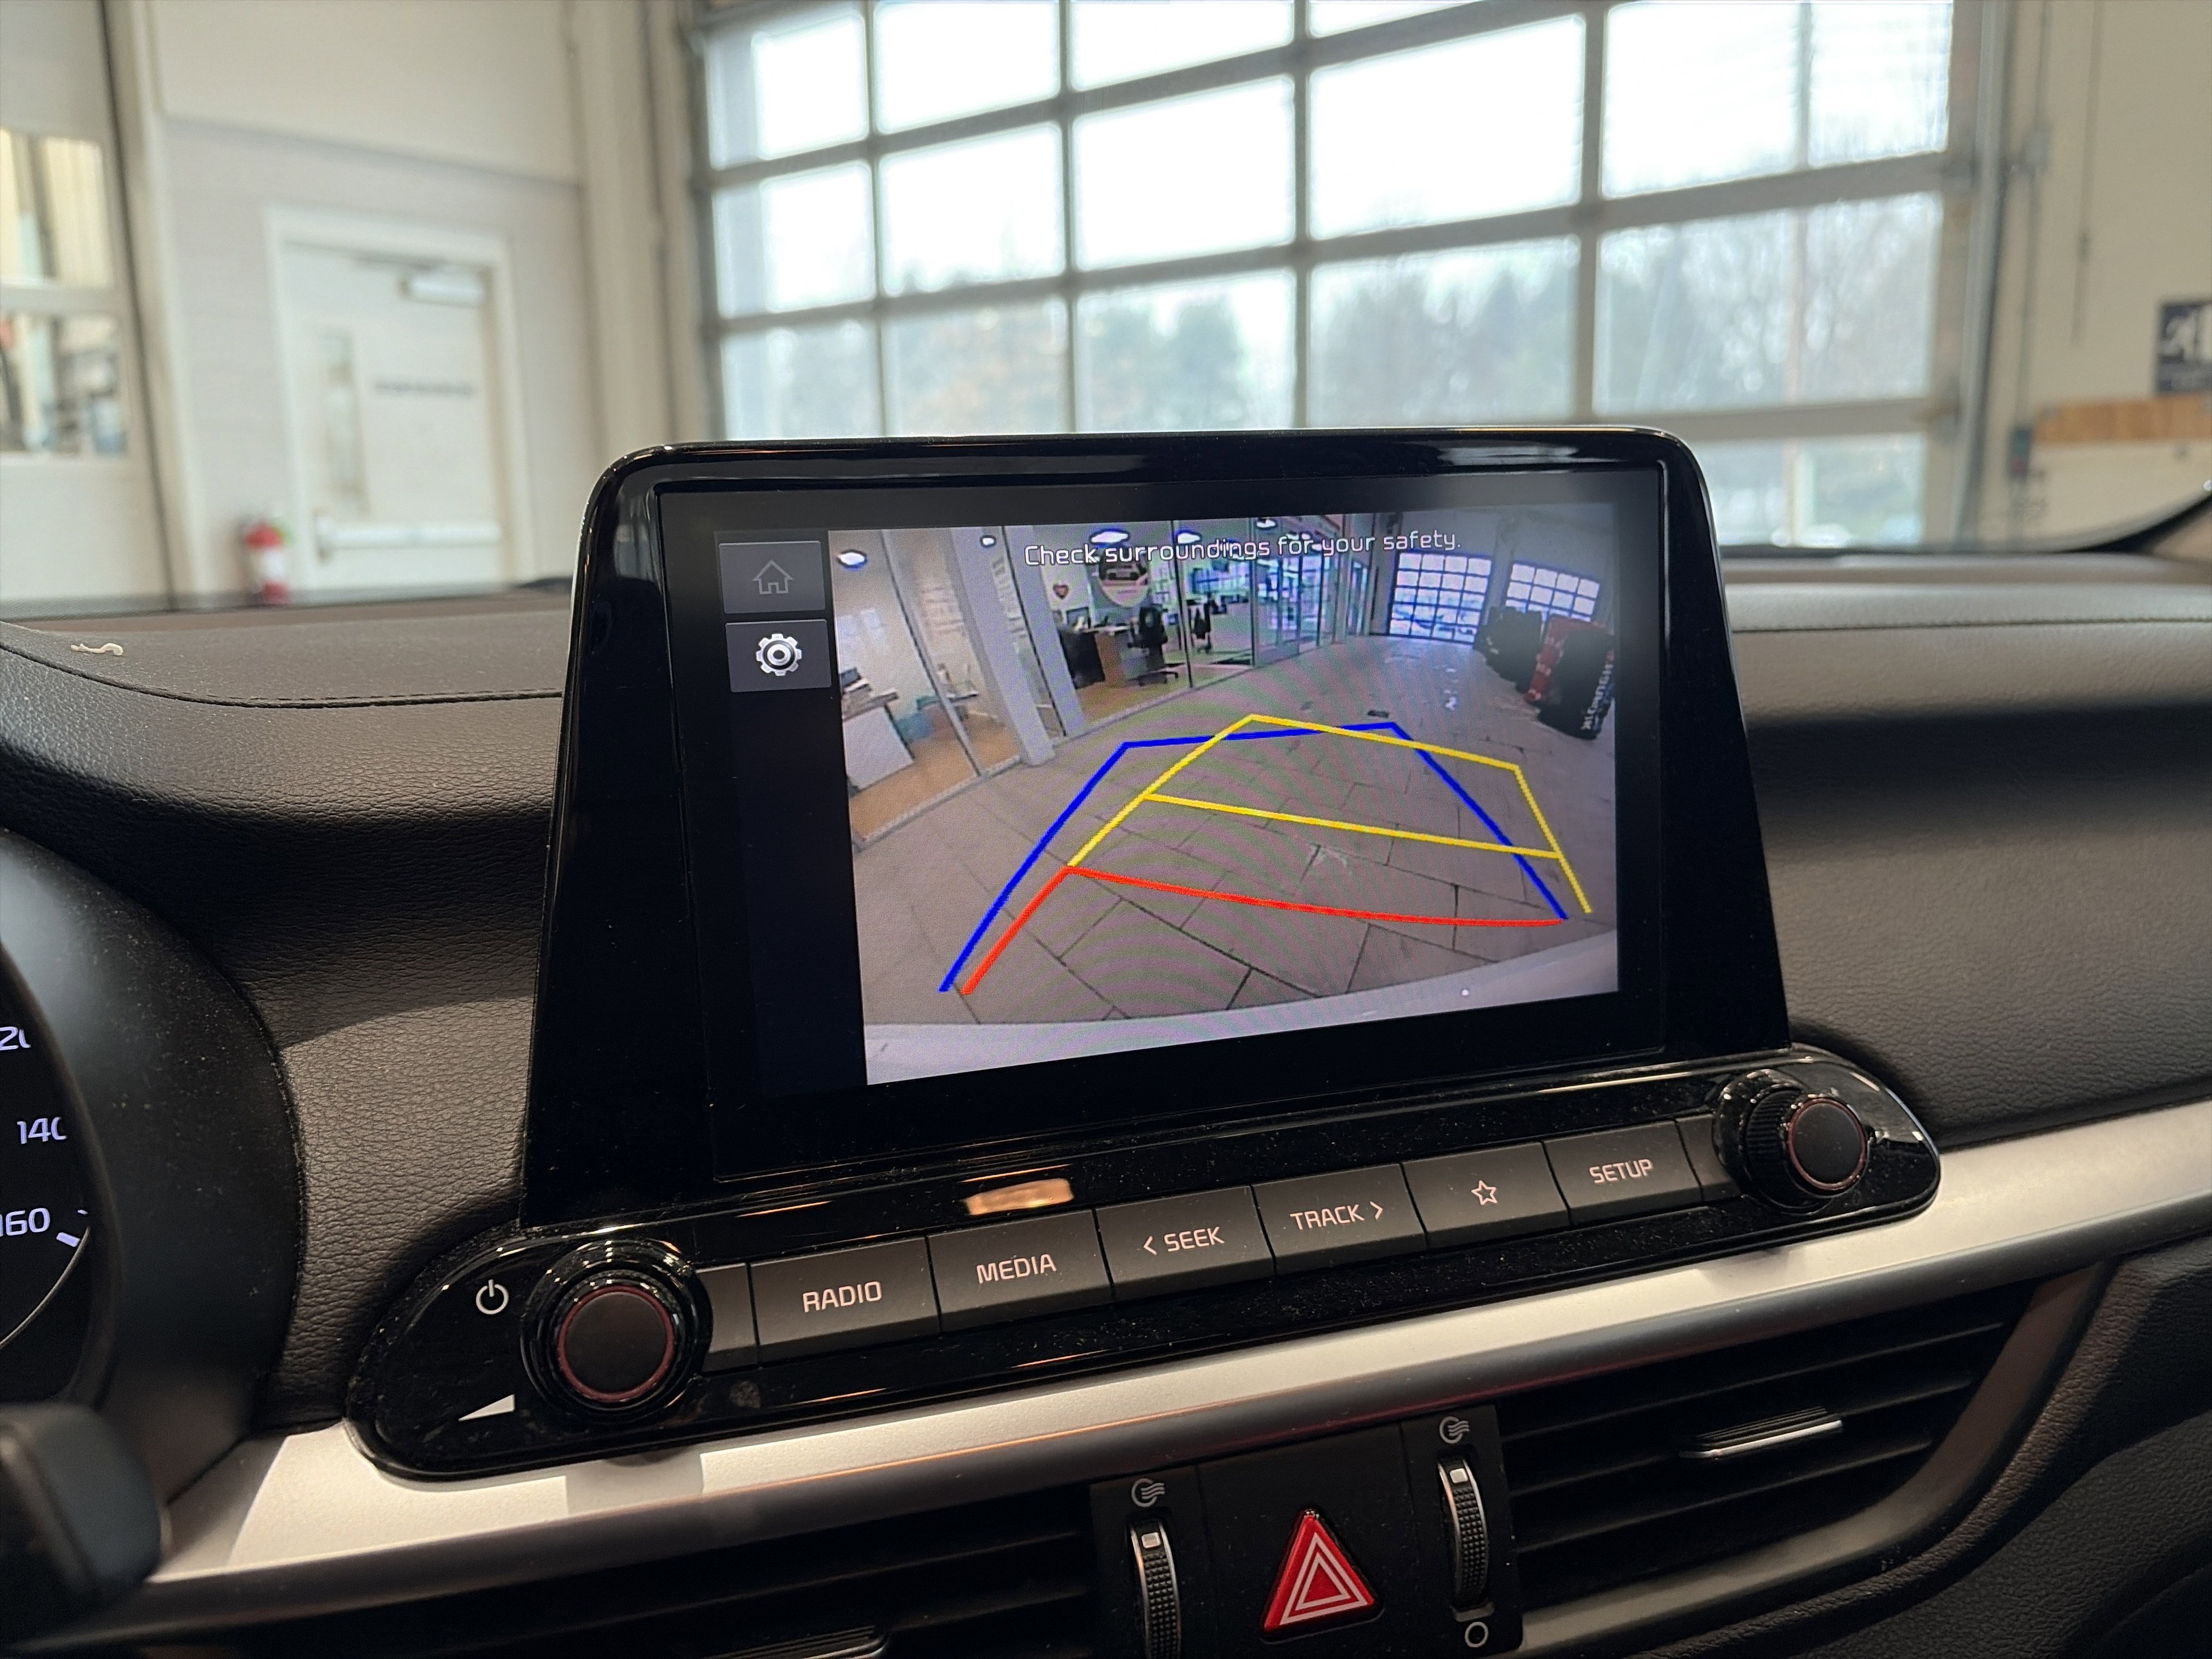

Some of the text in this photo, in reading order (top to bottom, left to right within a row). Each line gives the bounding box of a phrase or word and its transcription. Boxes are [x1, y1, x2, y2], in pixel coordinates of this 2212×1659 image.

[1025, 529, 1462, 566] Check surroundings for your safety.
[1589, 1159, 1654, 1184] SETUP
[1290, 1204, 1365, 1231] TRACK
[1164, 1226, 1226, 1252] SEEK
[976, 1254, 1057, 1284] MEDIA
[802, 1280, 882, 1313] RADIO
